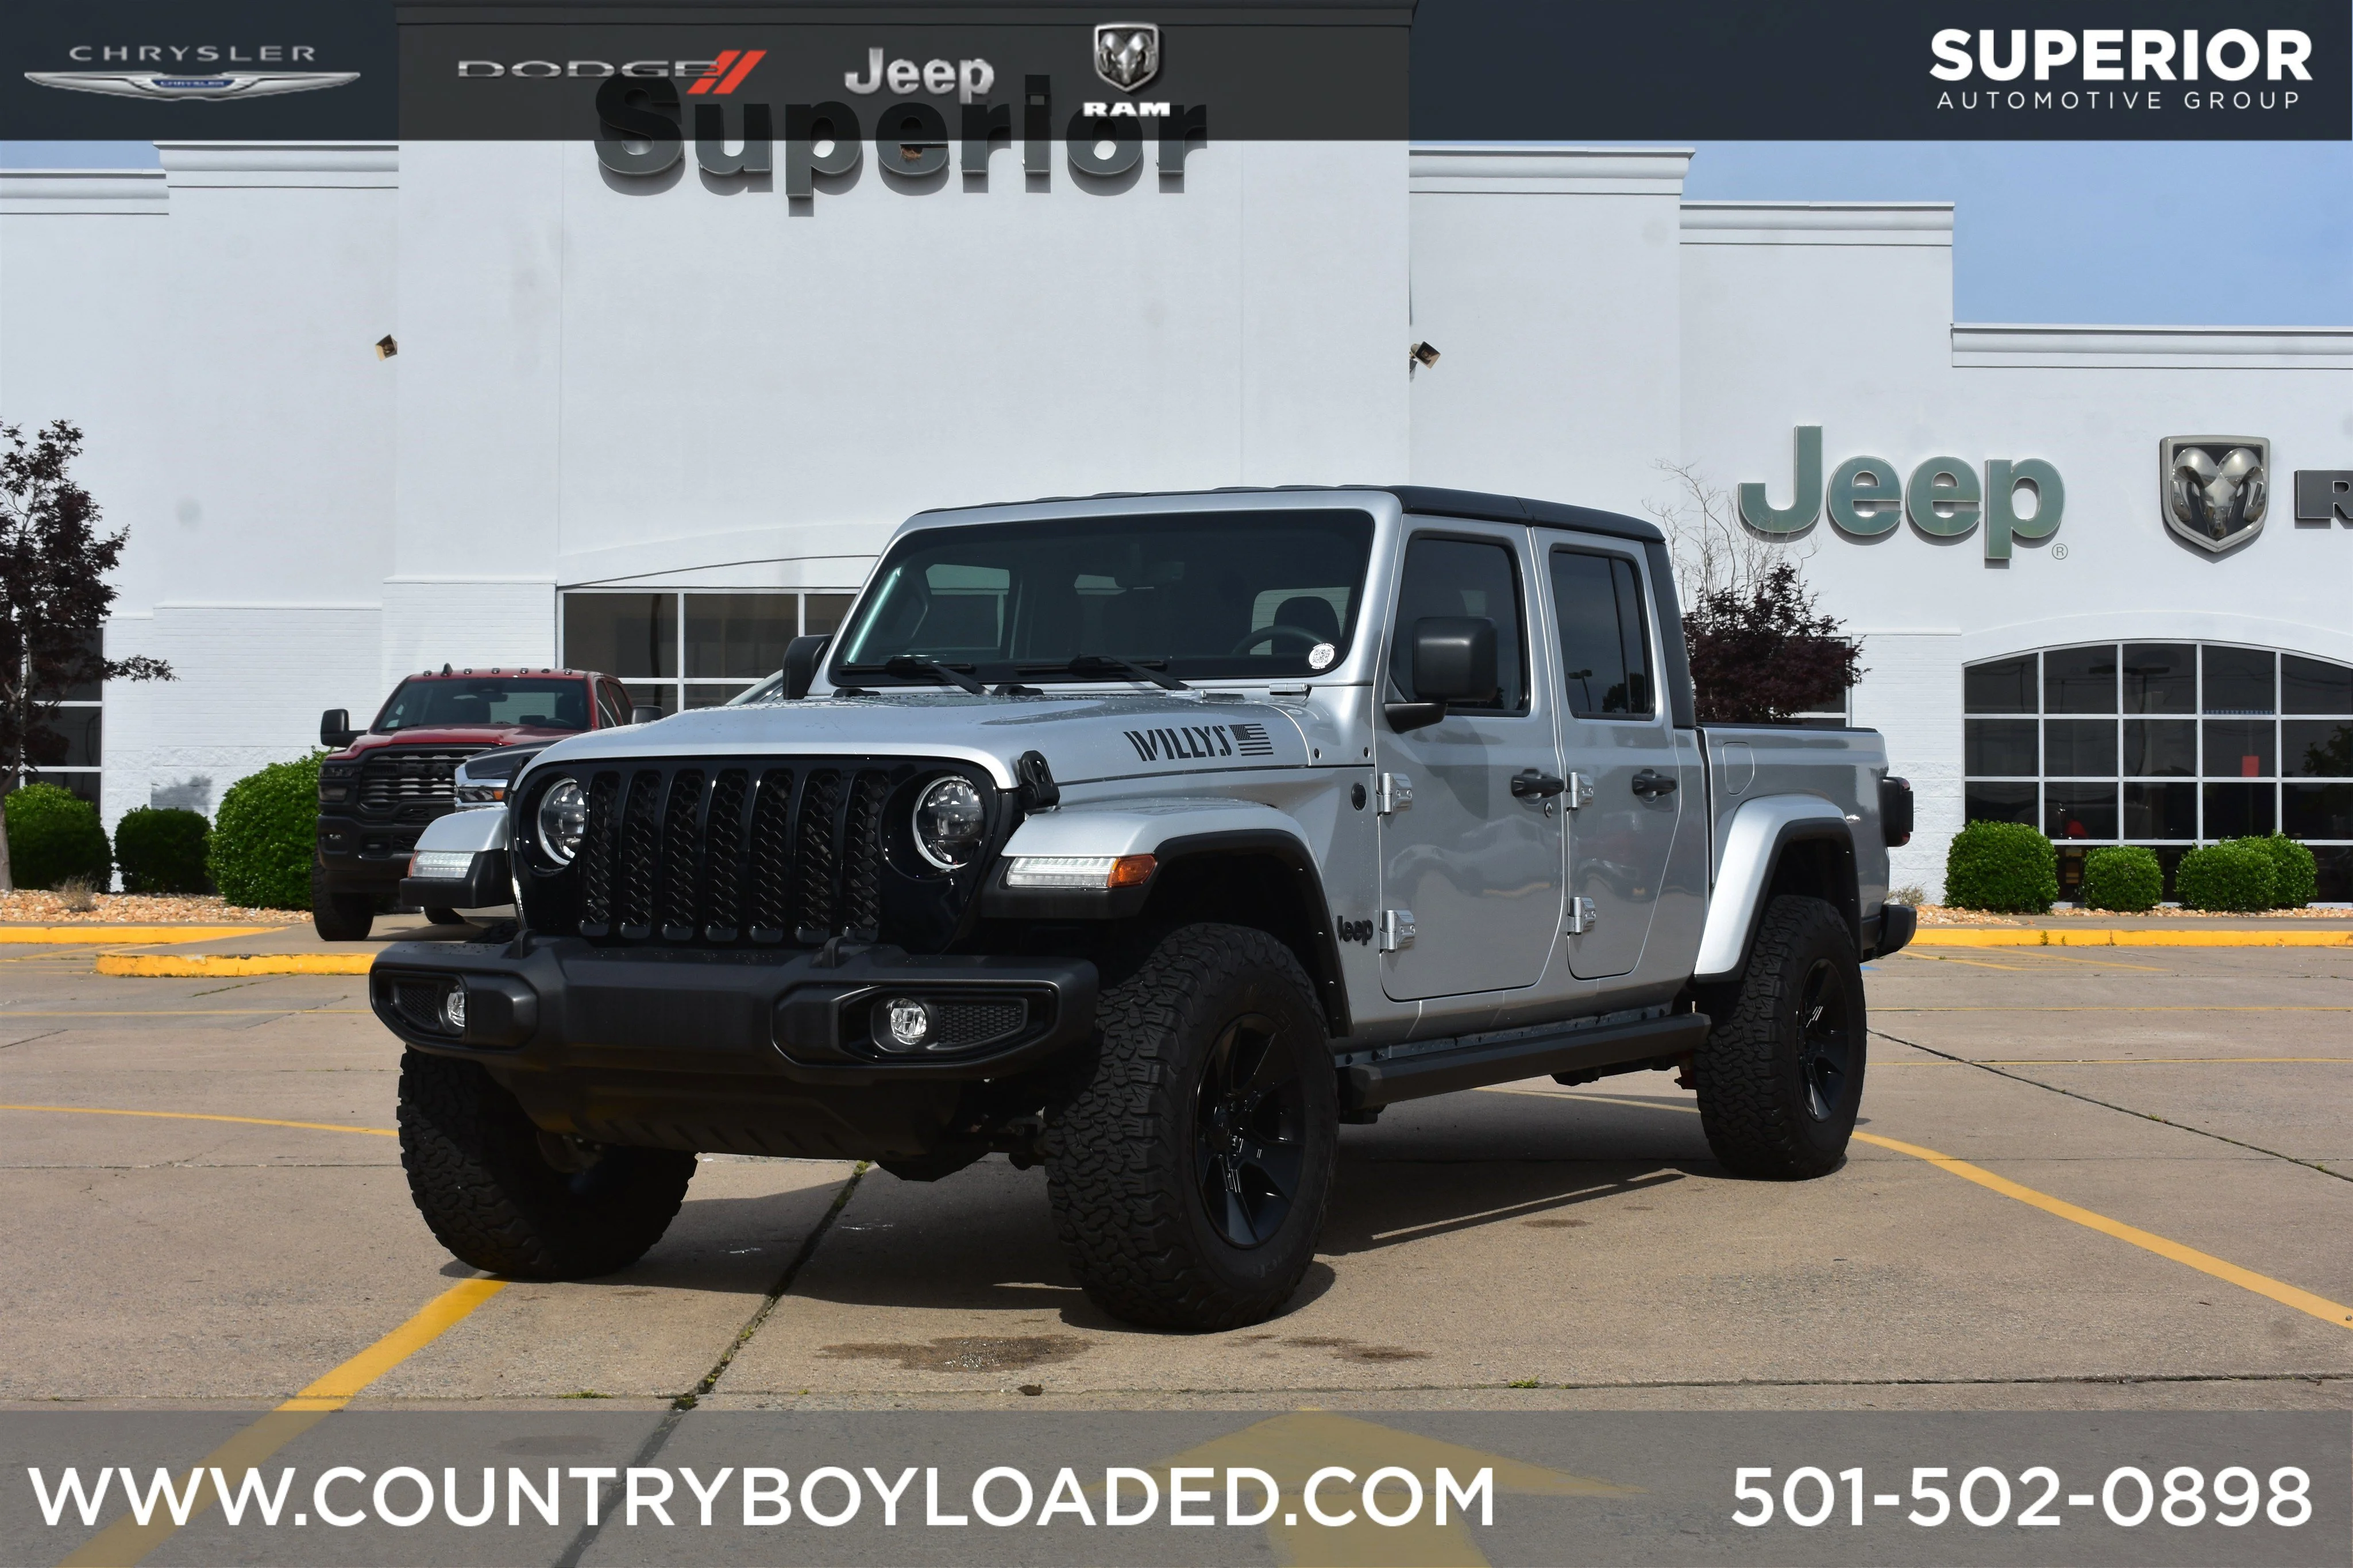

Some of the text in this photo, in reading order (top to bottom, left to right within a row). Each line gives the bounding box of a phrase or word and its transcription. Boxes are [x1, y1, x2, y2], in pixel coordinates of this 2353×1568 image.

[594, 73, 1207, 197] Superior
[1738, 425, 2065, 559] Jeep
[1123, 725, 1232, 762] WILLYS
[1337, 915, 1374, 946] Jeep
